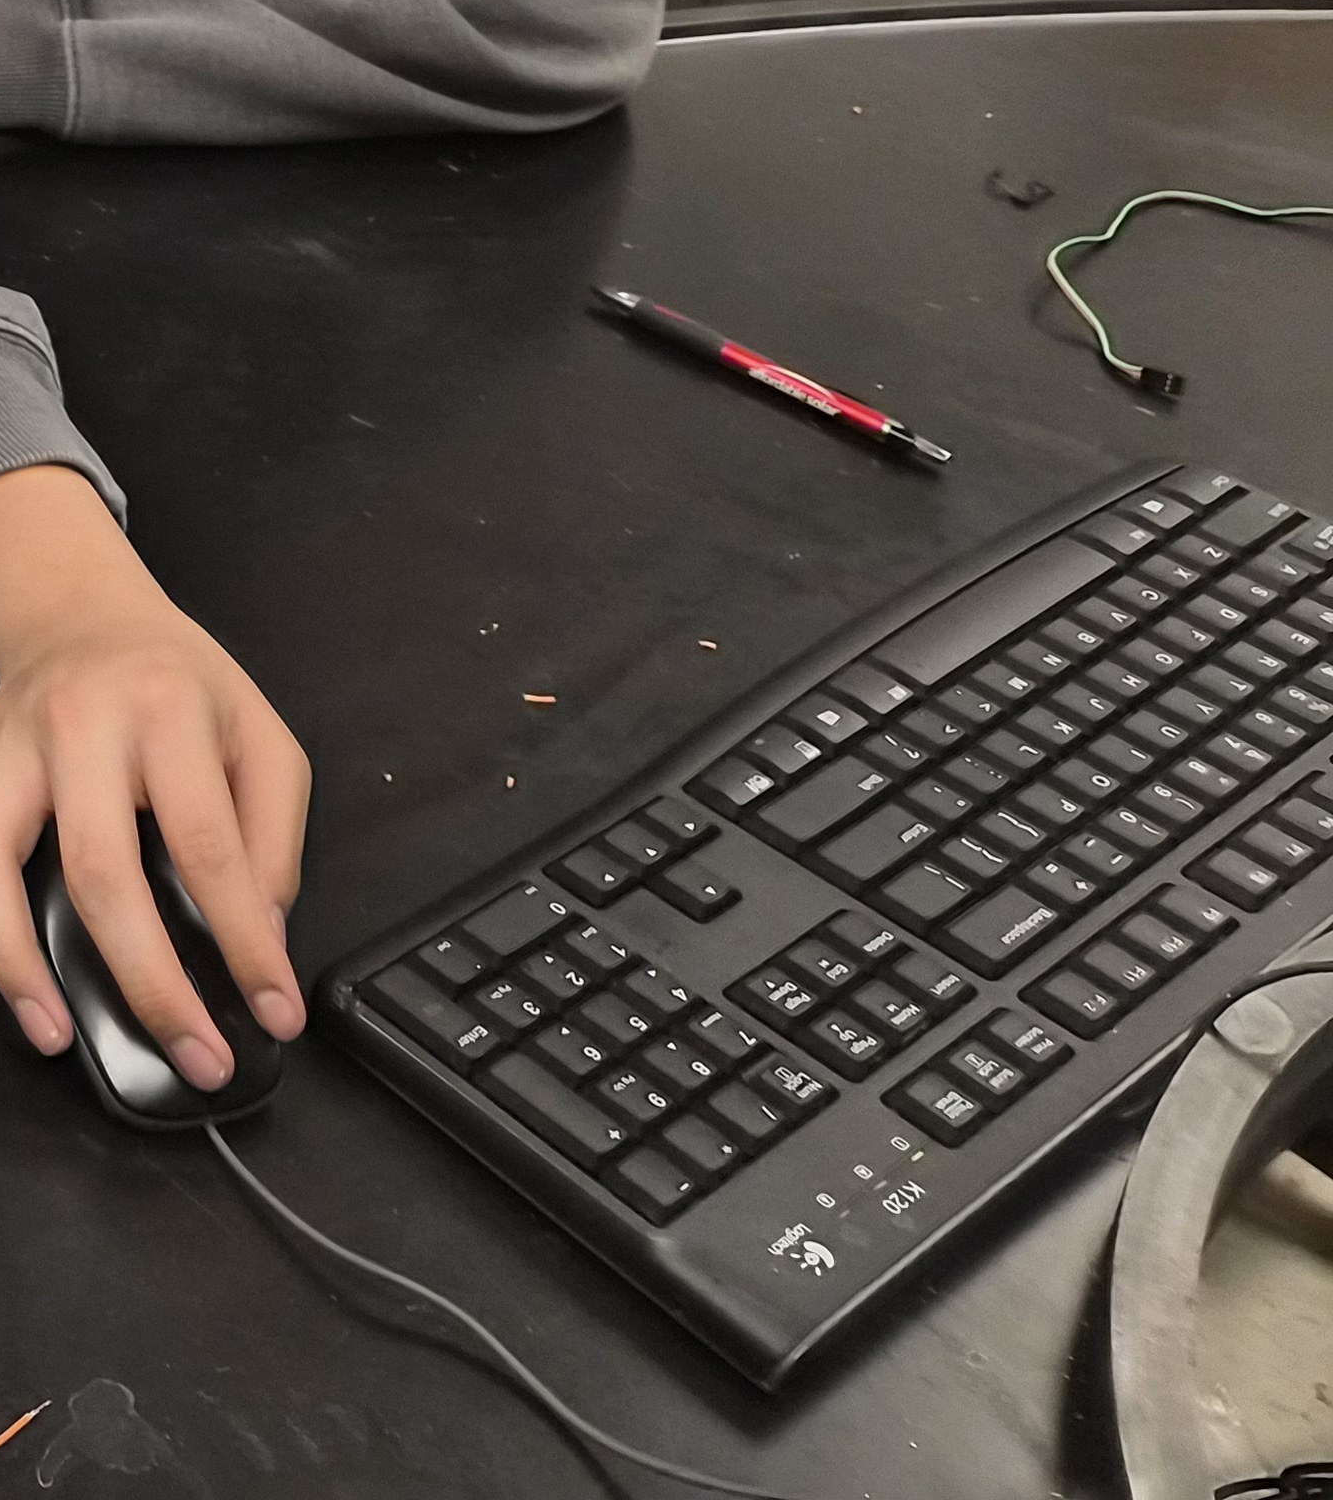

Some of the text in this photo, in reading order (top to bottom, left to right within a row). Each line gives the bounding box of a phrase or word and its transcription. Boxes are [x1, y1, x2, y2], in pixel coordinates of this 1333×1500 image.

[1203, 546, 1223, 559] Z
[1173, 567, 1192, 580] X
[1280, 564, 1298, 576] A
[1141, 590, 1159, 601] C
[1250, 586, 1269, 598] S
[1110, 612, 1128, 623] V
[1219, 608, 1239, 620] D
[1077, 632, 1096, 644] B
[1191, 630, 1207, 642] F
[1290, 632, 1311, 645] E
[1042, 654, 1063, 667] N
[1155, 653, 1174, 665] G
[1257, 656, 1279, 668] R
[1007, 676, 1029, 691] M
[1121, 674, 1142, 688] H
[1229, 680, 1248, 692] T
[1288, 689, 1307, 701] 5
[1089, 698, 1105, 711] J
[1196, 703, 1214, 715] Y
[1255, 712, 1274, 724] 6
[1052, 721, 1074, 735] K
[1160, 726, 1181, 739] U
[1224, 736, 1242, 749] 7
[903, 748, 920, 759] ?
[1019, 745, 1039, 755] L
[1130, 749, 1147, 760] I
[1091, 774, 1111, 787] O
[1154, 785, 1173, 797] 9
[1060, 799, 1077, 812] P
[1119, 811, 1137, 823] 0
[549, 902, 567, 915] 0
[1000, 907, 1054, 944] Backspace
[611, 945, 627, 958] 1
[565, 971, 585, 986] 2
[930, 973, 961, 996] Insert
[671, 988, 688, 1001] 4
[523, 1001, 541, 1015] 3
[629, 1016, 648, 1031] 5
[457, 1024, 489, 1048] Enter
[739, 1031, 756, 1046] 7
[583, 1046, 602, 1061] 6
[691, 1061, 711, 1076] 8
[796, 1078, 824, 1099] Num
[648, 1093, 667, 1108] 9
[761, 1105, 777, 1121] /
[882, 1180, 926, 1215] K120
[767, 1222, 813, 1256] Logitech
